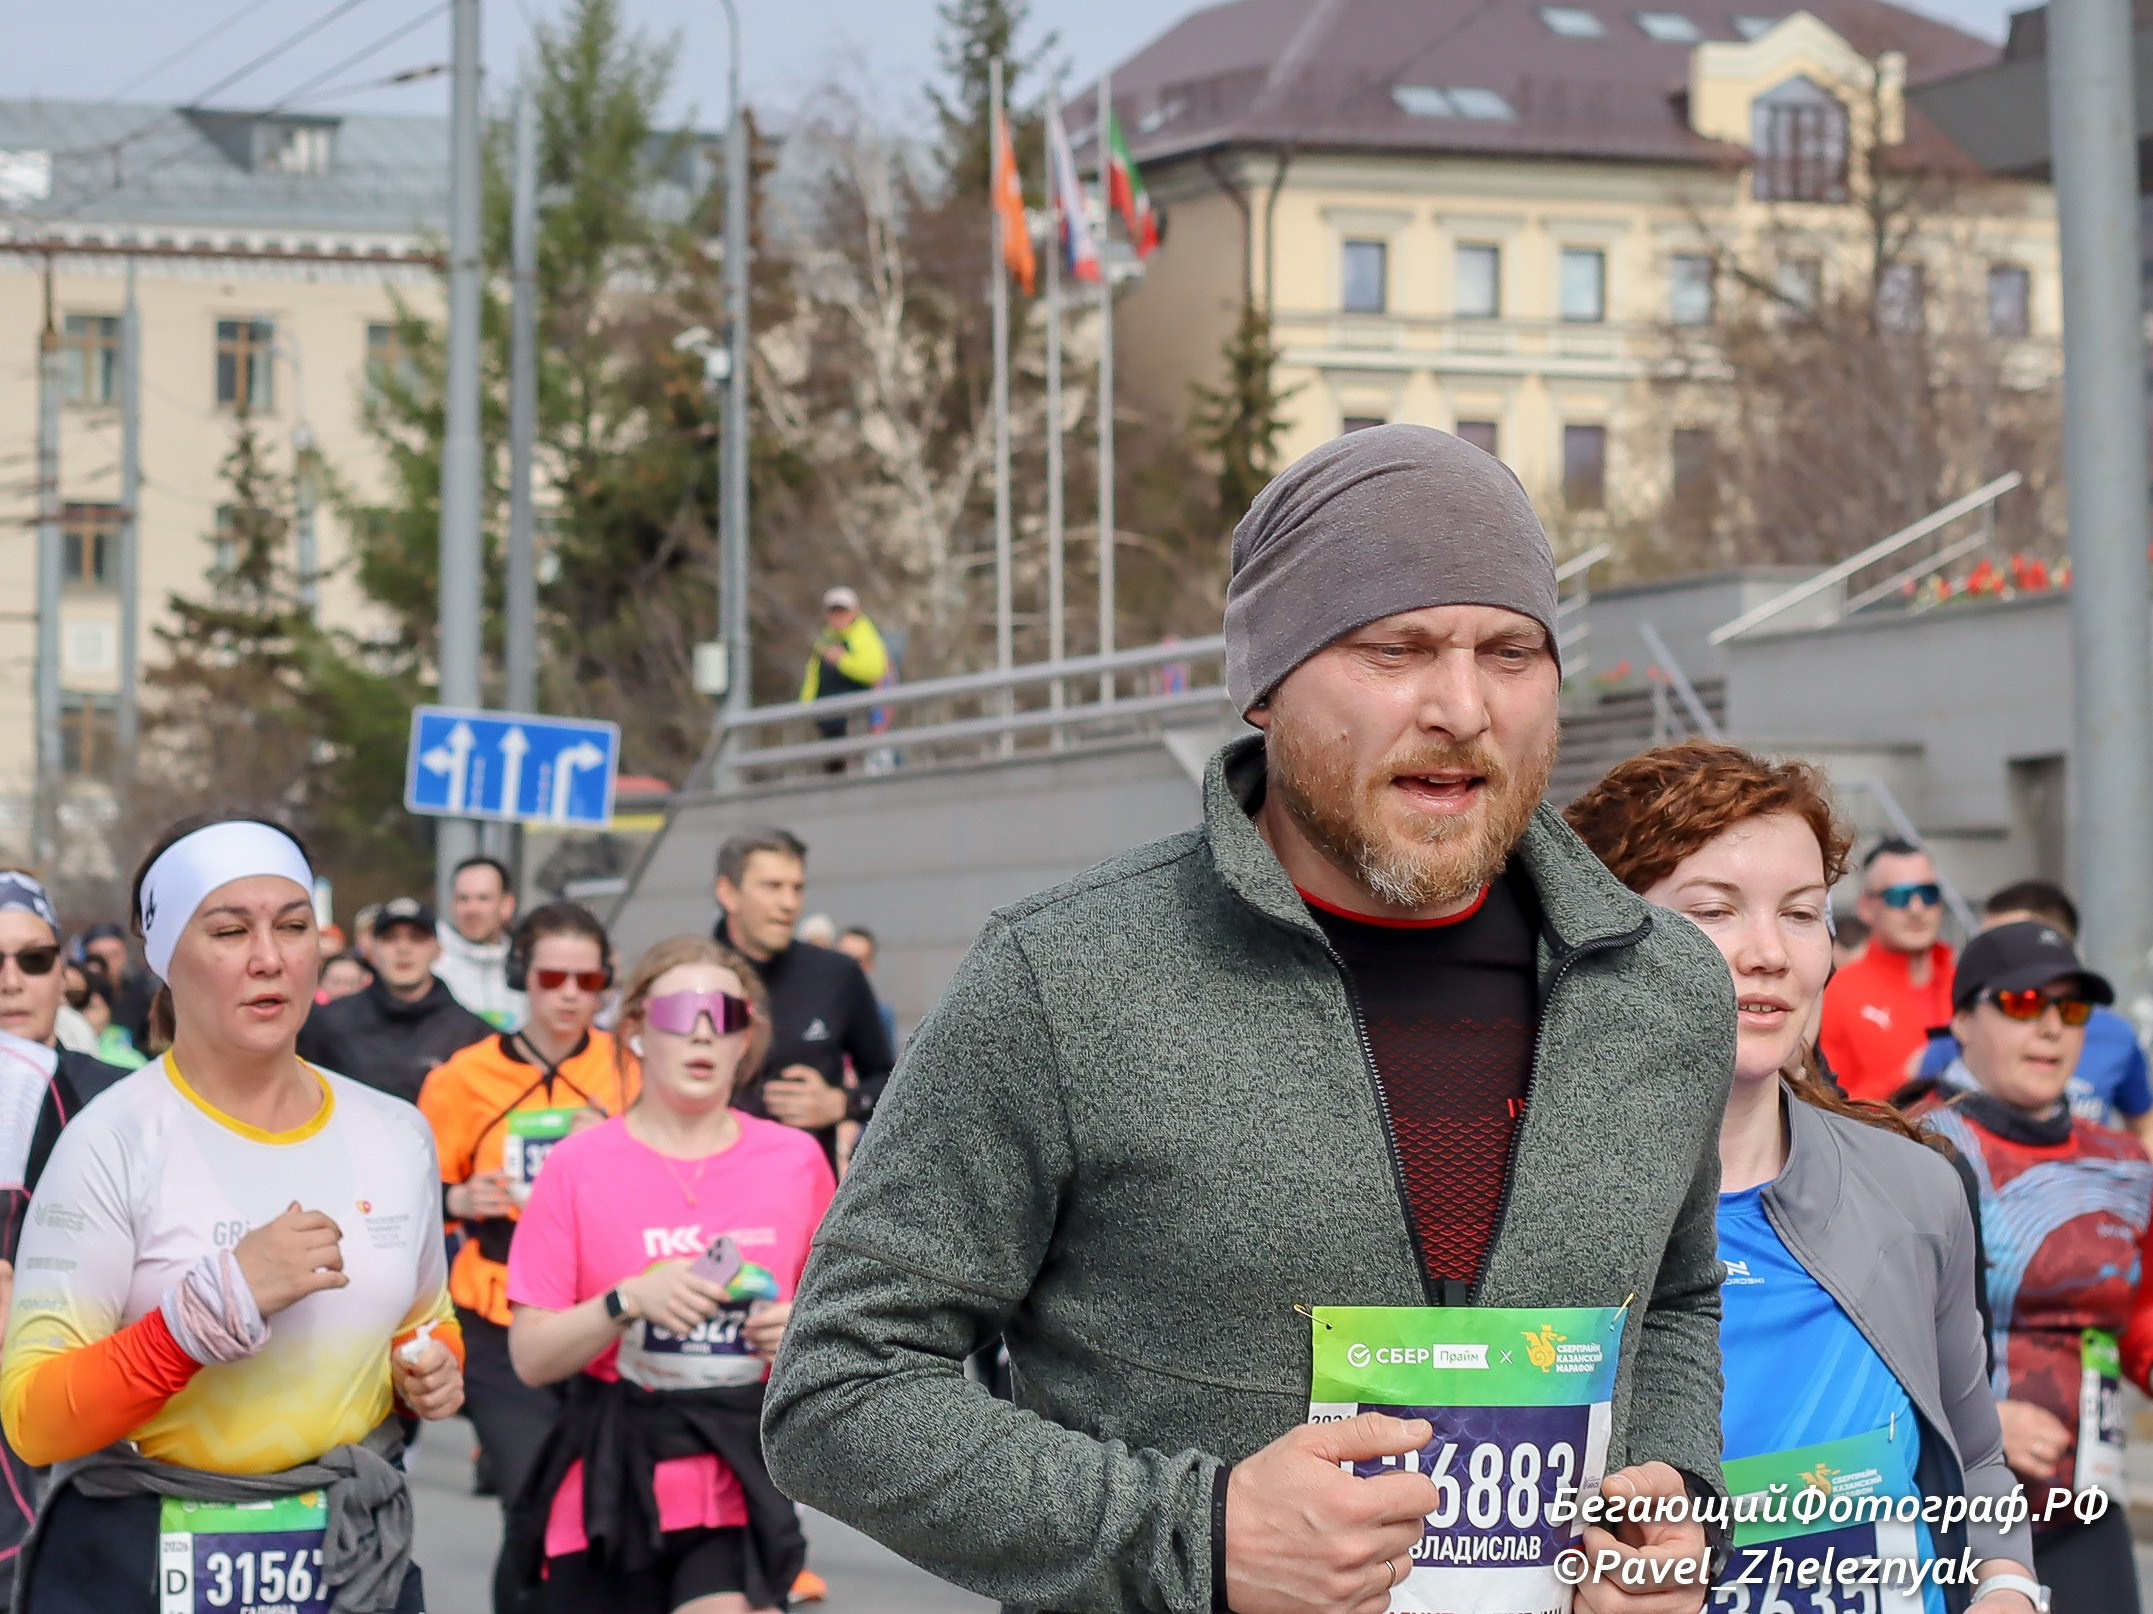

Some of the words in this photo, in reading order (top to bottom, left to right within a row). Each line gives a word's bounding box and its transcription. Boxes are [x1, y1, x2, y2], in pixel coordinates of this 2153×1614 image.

[1375, 1347, 1430, 1365] СБЕР
[1440, 1349, 1479, 1364] Прайм
[1556, 1352, 1603, 1363] КАЗАНСКИЙ
[1556, 1363, 1595, 1373] МАРАФОН
[1381, 1441, 1576, 1531] 6883
[1409, 1535, 1541, 1565] ВЛАДИСЛАВ
[166, 1568, 188, 1595] D
